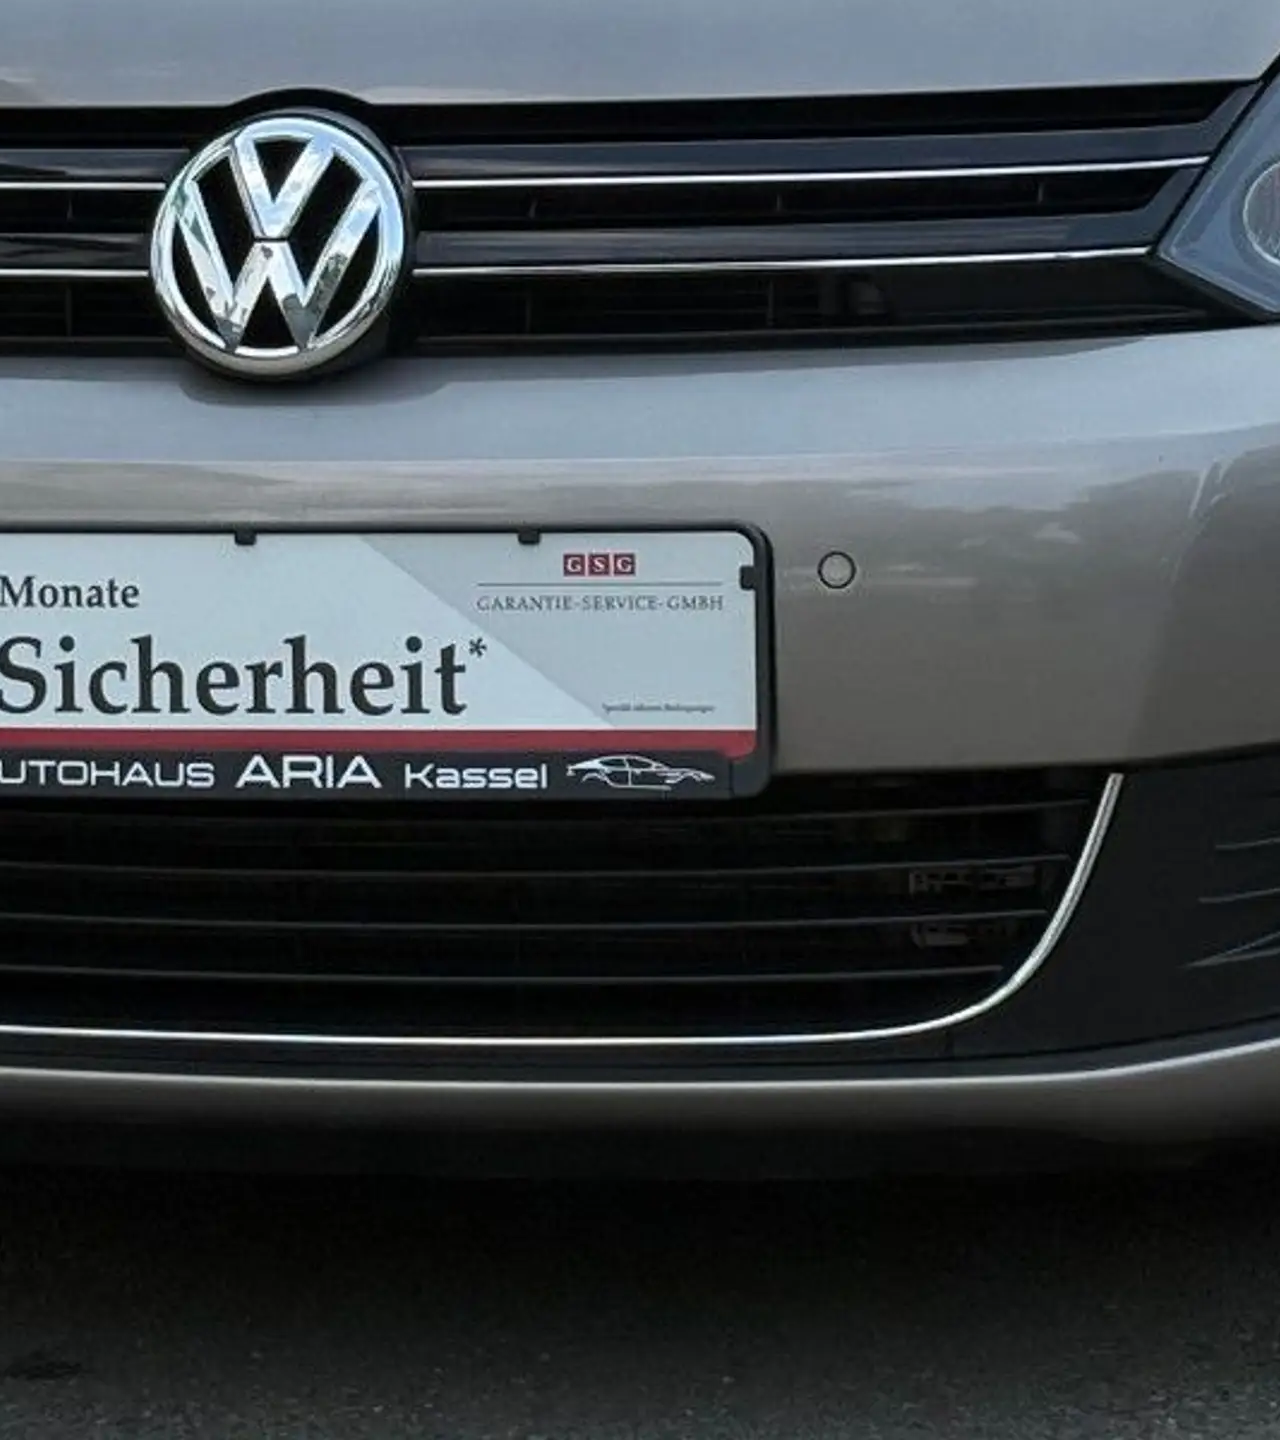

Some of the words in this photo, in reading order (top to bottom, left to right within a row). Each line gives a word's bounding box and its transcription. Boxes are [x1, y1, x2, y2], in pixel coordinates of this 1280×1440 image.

[566, 556, 633, 574] GSG
[234, 754, 383, 790] ARIA
[404, 761, 549, 790] Kassel
